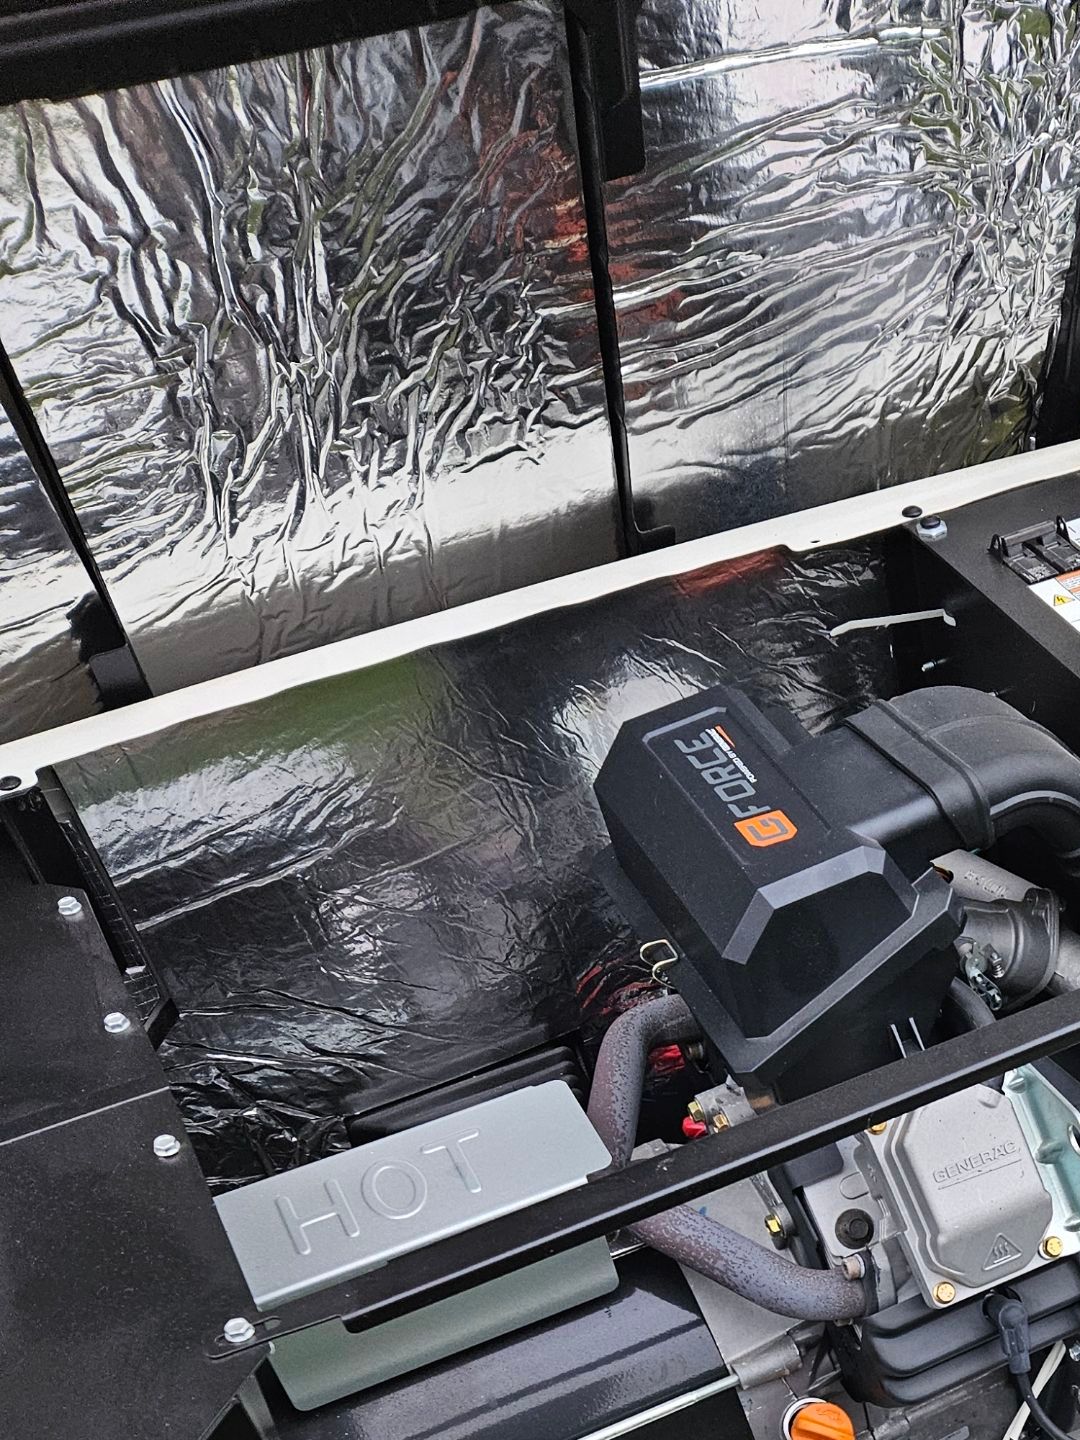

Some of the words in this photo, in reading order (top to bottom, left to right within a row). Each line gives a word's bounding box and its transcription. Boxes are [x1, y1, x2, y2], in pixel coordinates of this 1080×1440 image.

[732, 757, 758, 784] POWERED
[932, 1142, 1018, 1184] GENERAC
[274, 1127, 481, 1256] HOT
